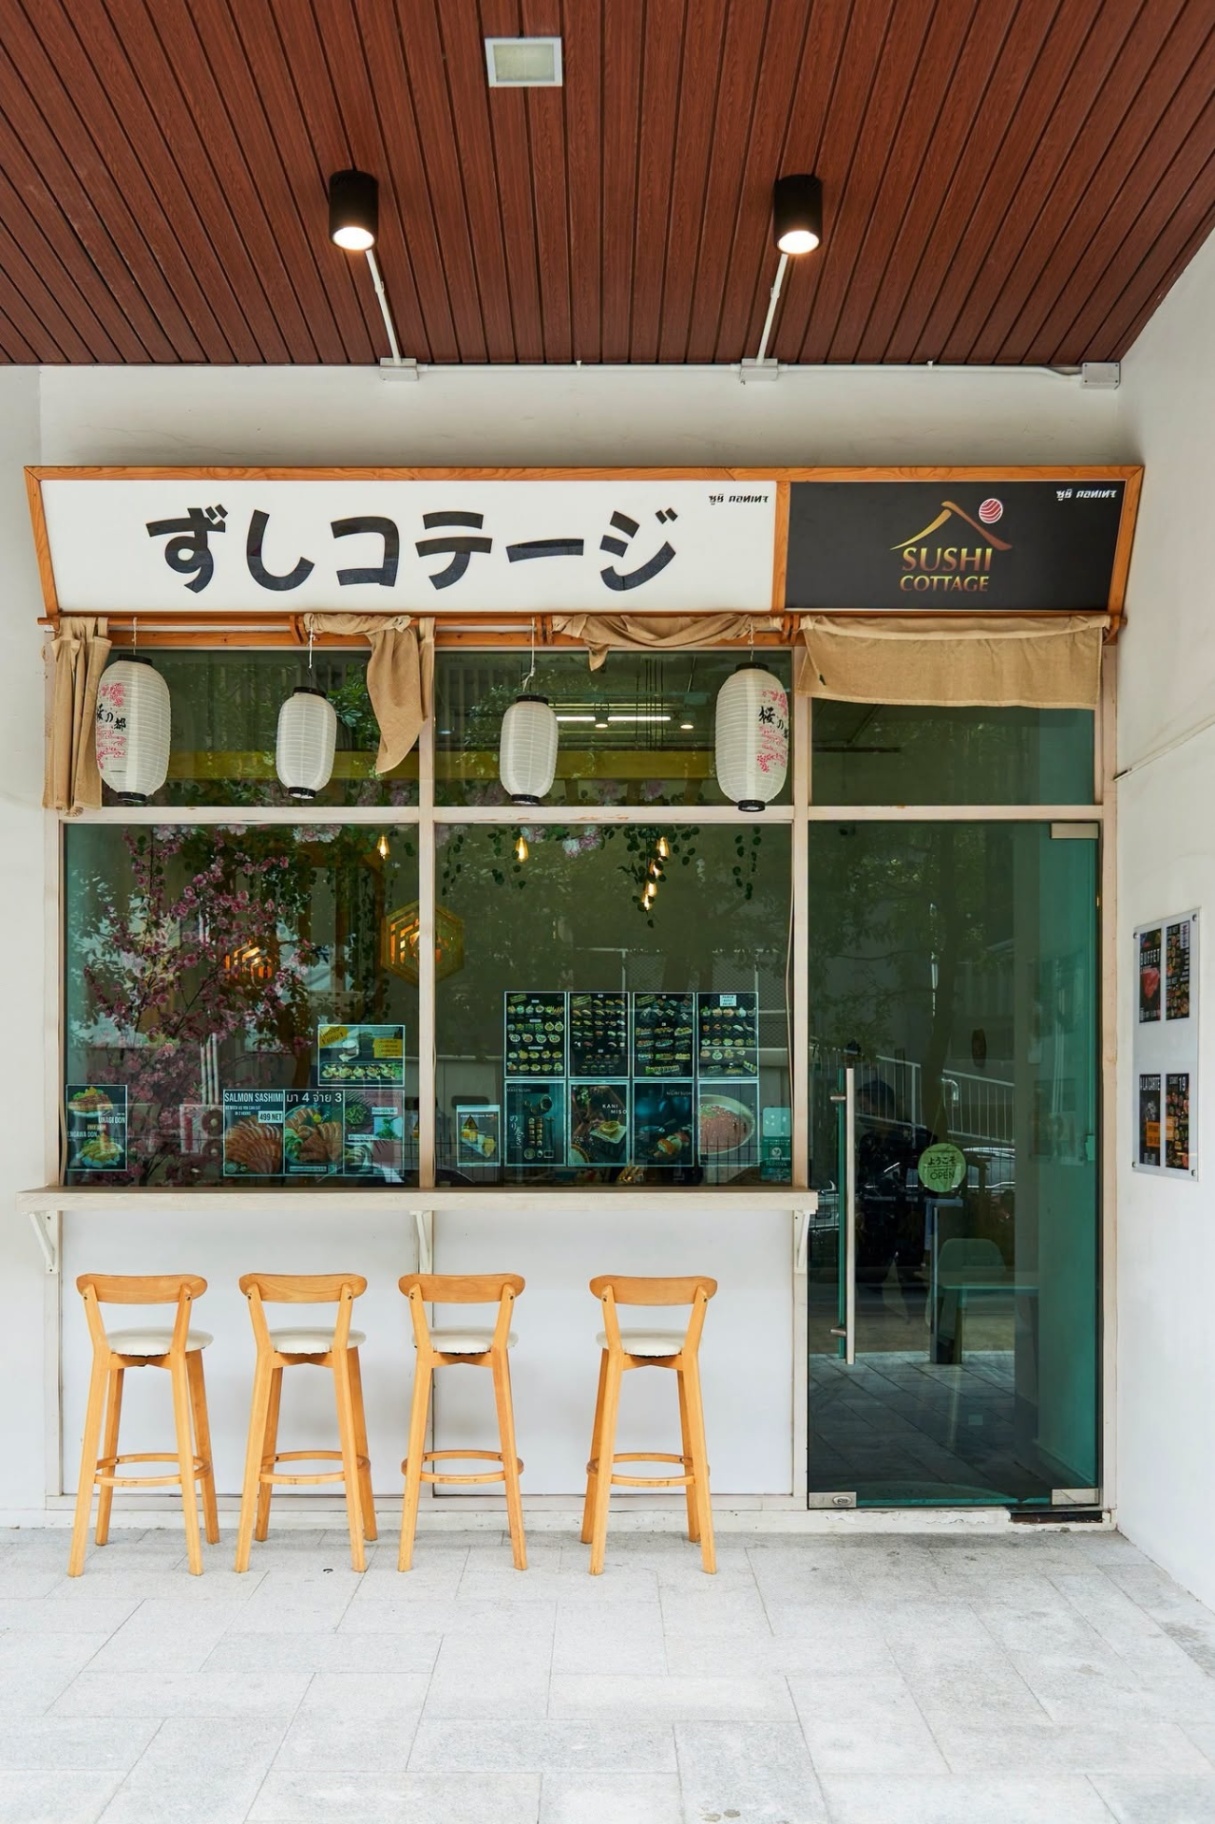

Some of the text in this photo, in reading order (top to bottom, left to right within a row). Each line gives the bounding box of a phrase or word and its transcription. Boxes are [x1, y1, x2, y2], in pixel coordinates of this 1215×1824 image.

[146, 504, 678, 593] ずしコテージ
[902, 547, 993, 571] SUSHI
[900, 575, 989, 592] COTTAGE
[225, 1093, 284, 1102] SALMON SASHIMI
[287, 1091, 342, 1102] มา 4 จ่าย 3
[260, 1113, 282, 1121] 499 NET
[928, 1156, 955, 1165] ようこそ
[930, 1171, 955, 1180] OPEN
